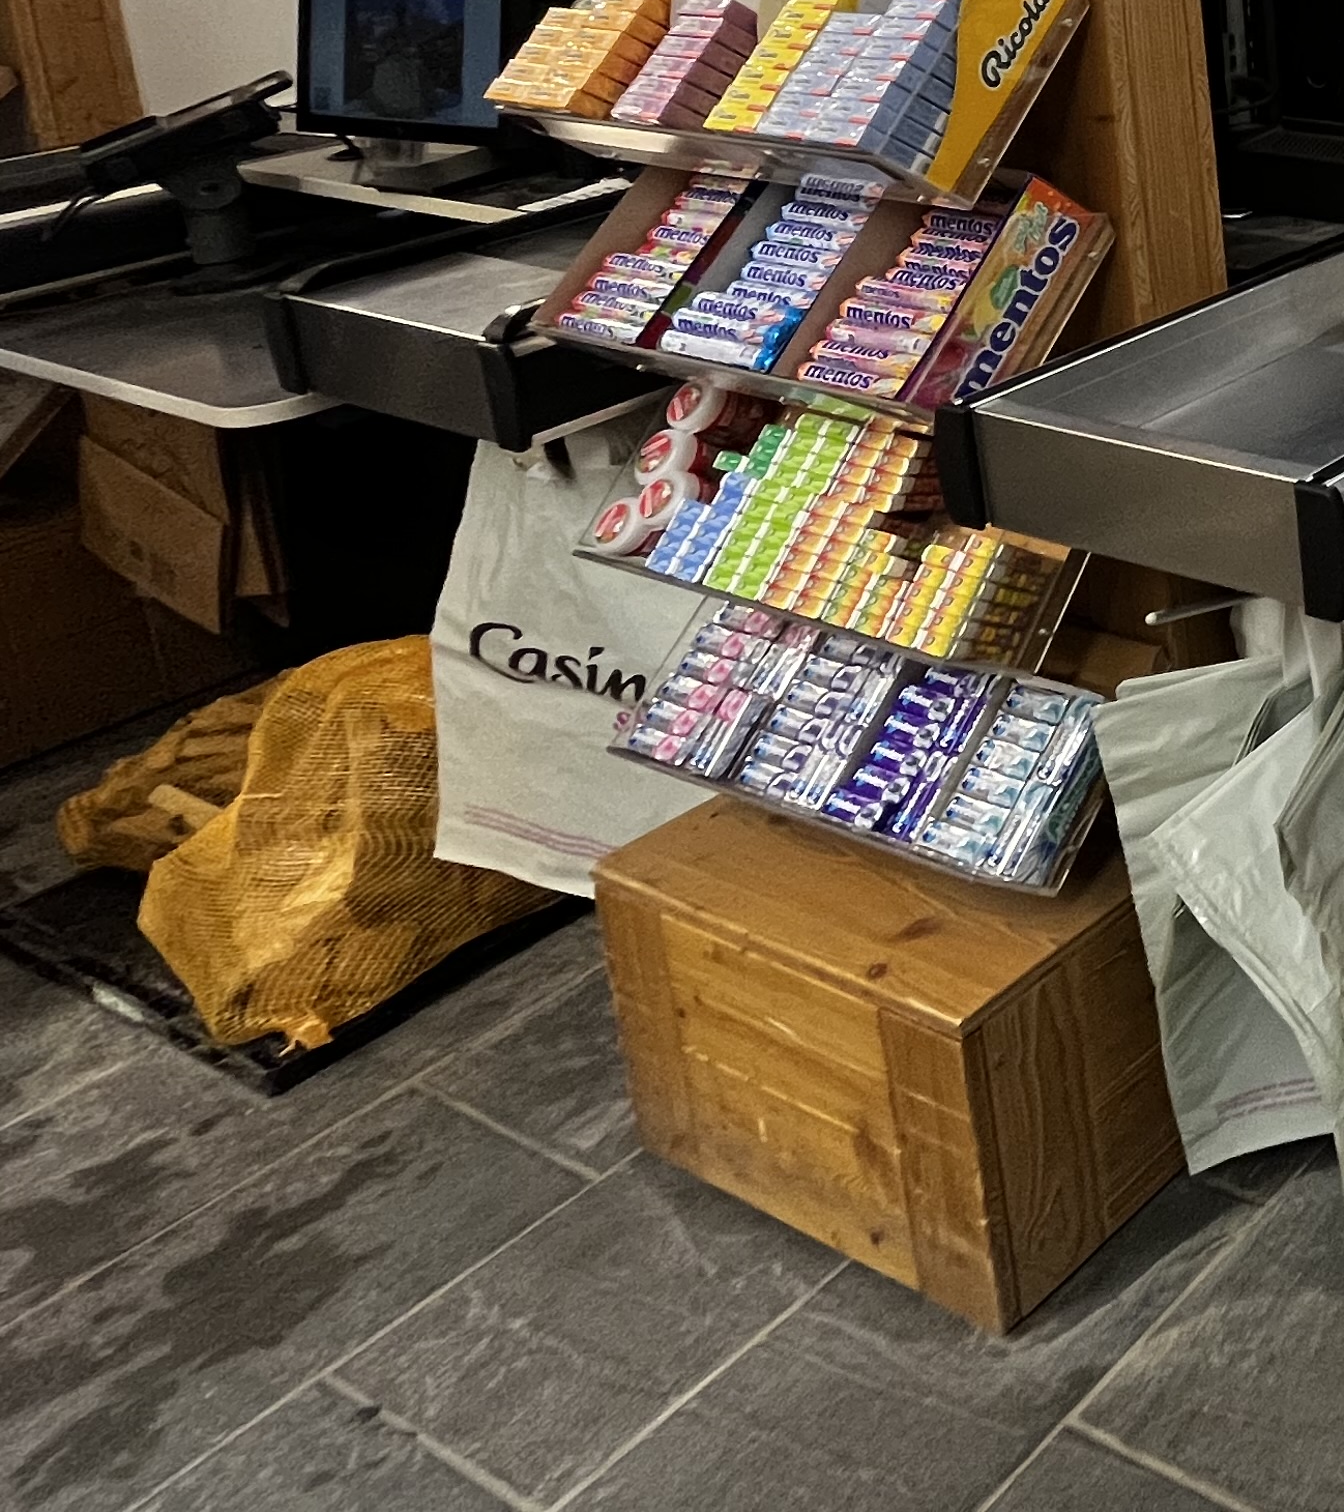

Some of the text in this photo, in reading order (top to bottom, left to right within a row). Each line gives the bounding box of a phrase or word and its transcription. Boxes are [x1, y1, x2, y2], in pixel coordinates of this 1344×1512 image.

[788, 204, 849, 221] mentos
[655, 225, 710, 246] mentos
[774, 223, 836, 242] mentos
[930, 215, 993, 235] mentos
[758, 241, 820, 264] mentos
[918, 242, 982, 263] mentos
[746, 265, 808, 287] mentos
[891, 270, 960, 290] mentos
[698, 298, 758, 321] mentos
[846, 306, 912, 329] mentos
[953, 215, 1079, 401] mentos
[677, 317, 738, 339] mentos
[804, 364, 874, 390] mentos
[470, 622, 647, 702] Casin
